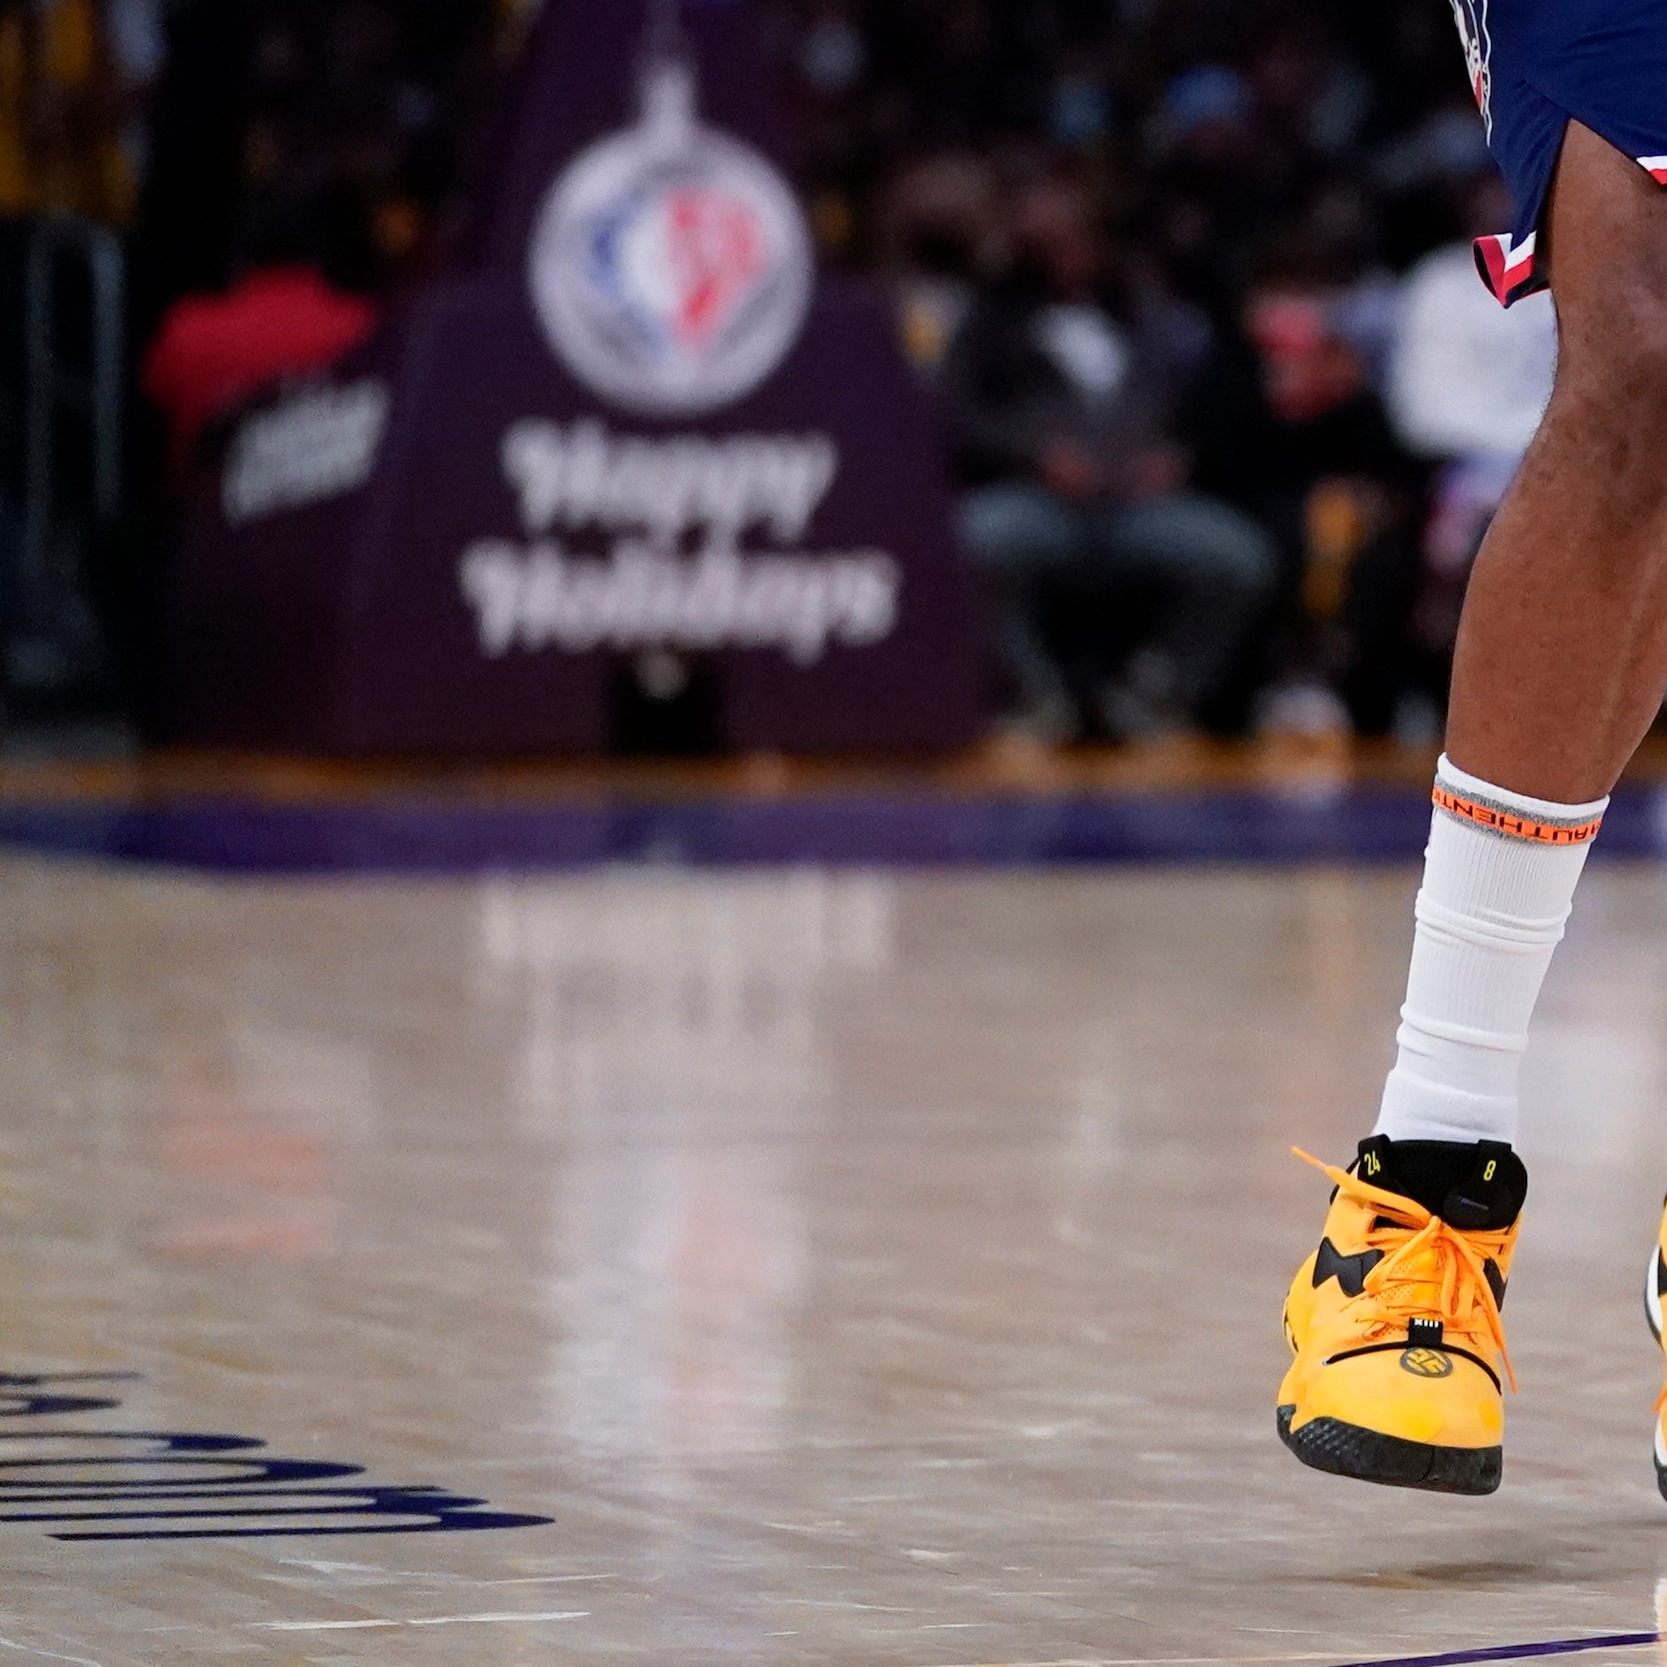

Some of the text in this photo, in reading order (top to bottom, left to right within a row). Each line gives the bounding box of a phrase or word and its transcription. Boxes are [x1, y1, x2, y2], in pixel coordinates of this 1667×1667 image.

[503, 419, 837, 539] Happy
[459, 541, 898, 665] Holidays
[1364, 1150, 1381, 1176] 24
[1483, 1160, 1497, 1181] 8
